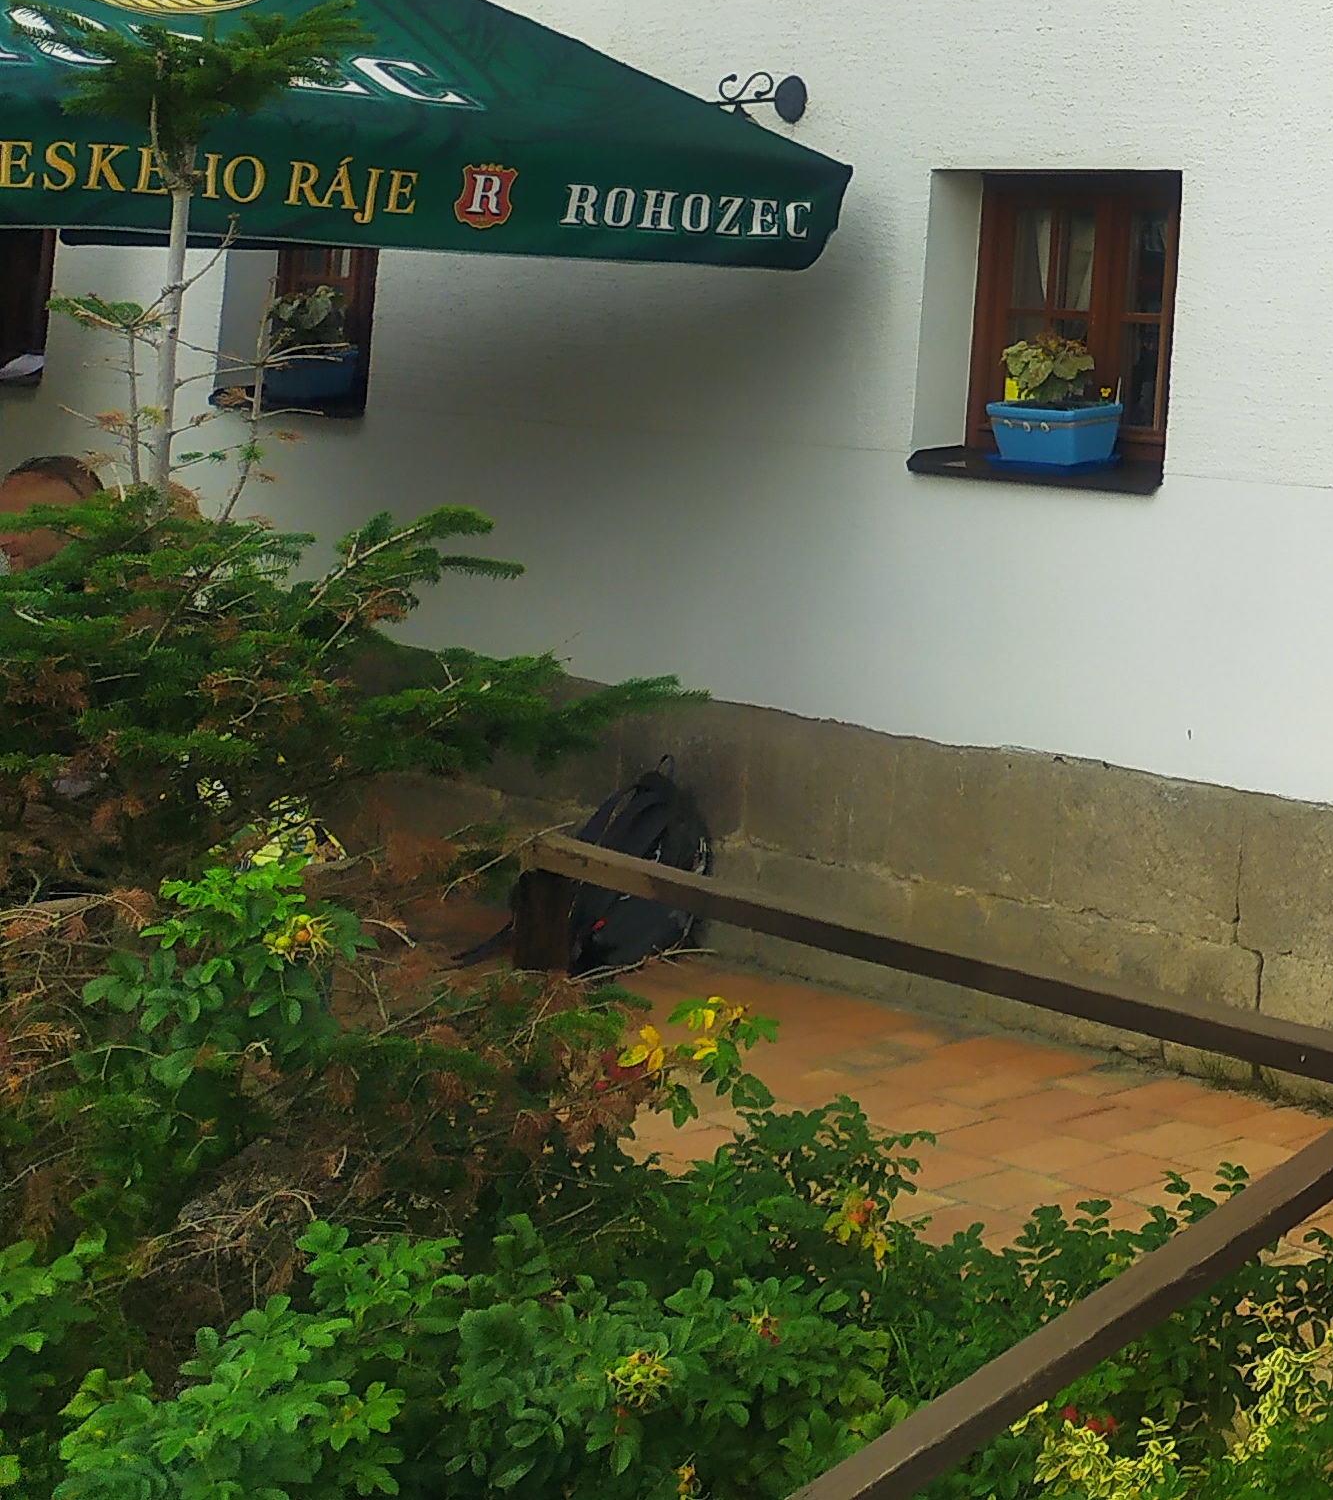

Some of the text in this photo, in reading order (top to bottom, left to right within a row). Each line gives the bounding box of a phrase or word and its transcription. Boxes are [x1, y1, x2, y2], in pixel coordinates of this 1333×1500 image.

[284, 156, 420, 224] RÁJE
[465, 173, 502, 215] R
[558, 182, 813, 239] ROHOZEC
